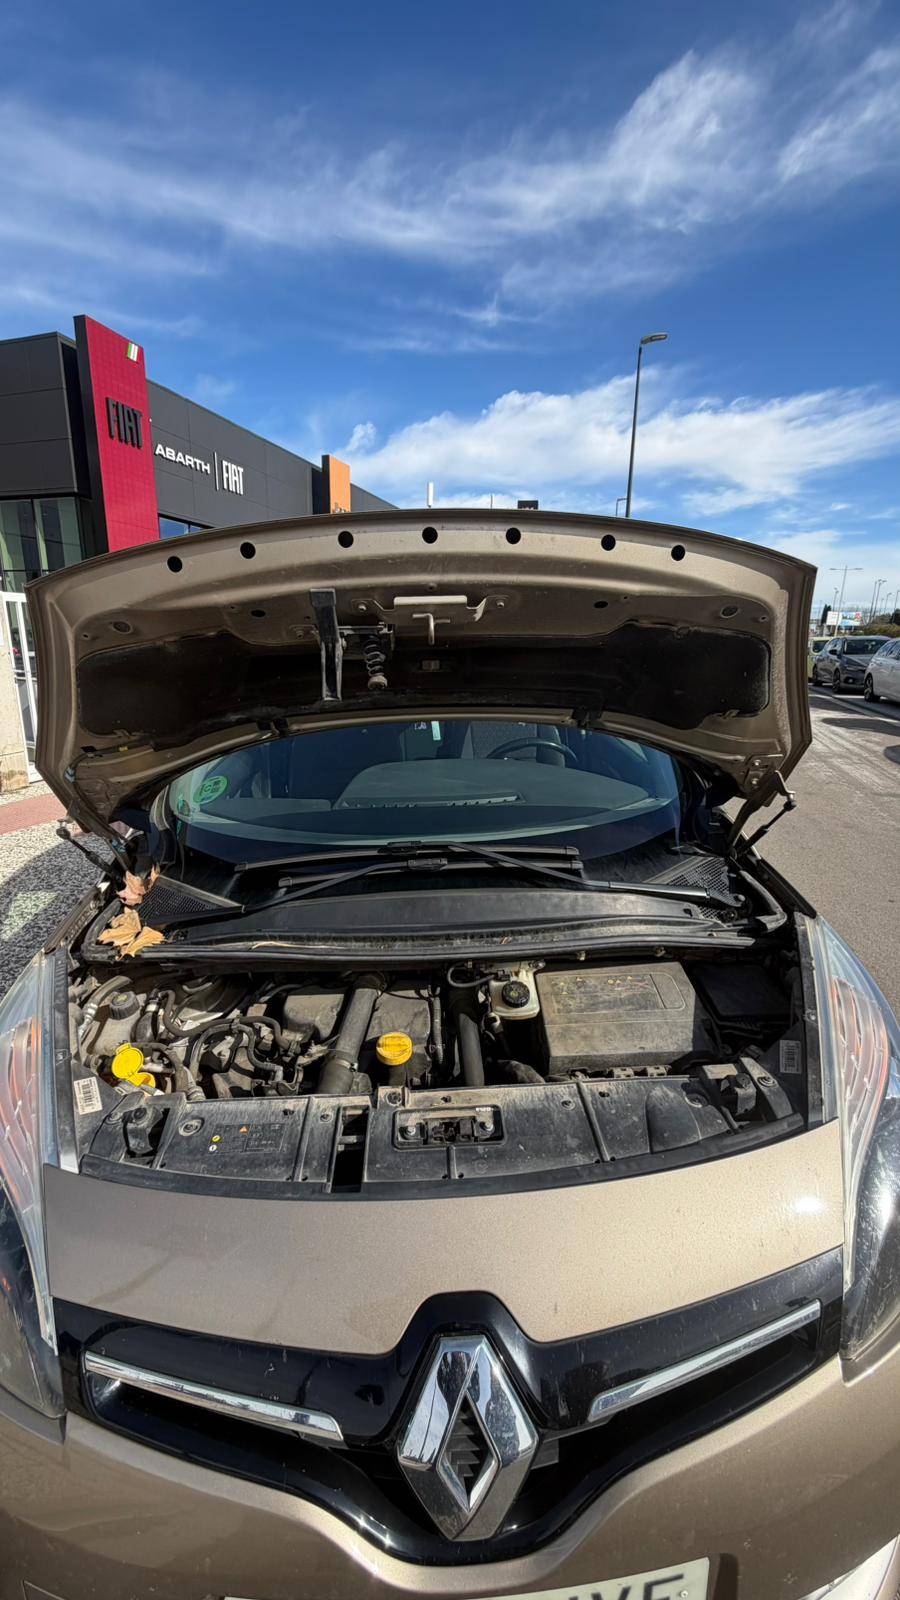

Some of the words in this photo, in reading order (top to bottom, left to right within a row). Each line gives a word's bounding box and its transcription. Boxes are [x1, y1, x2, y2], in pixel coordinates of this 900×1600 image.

[105, 397, 142, 449] FIAT
[155, 443, 211, 475] ABARTH
[222, 459, 244, 495] FIAT
